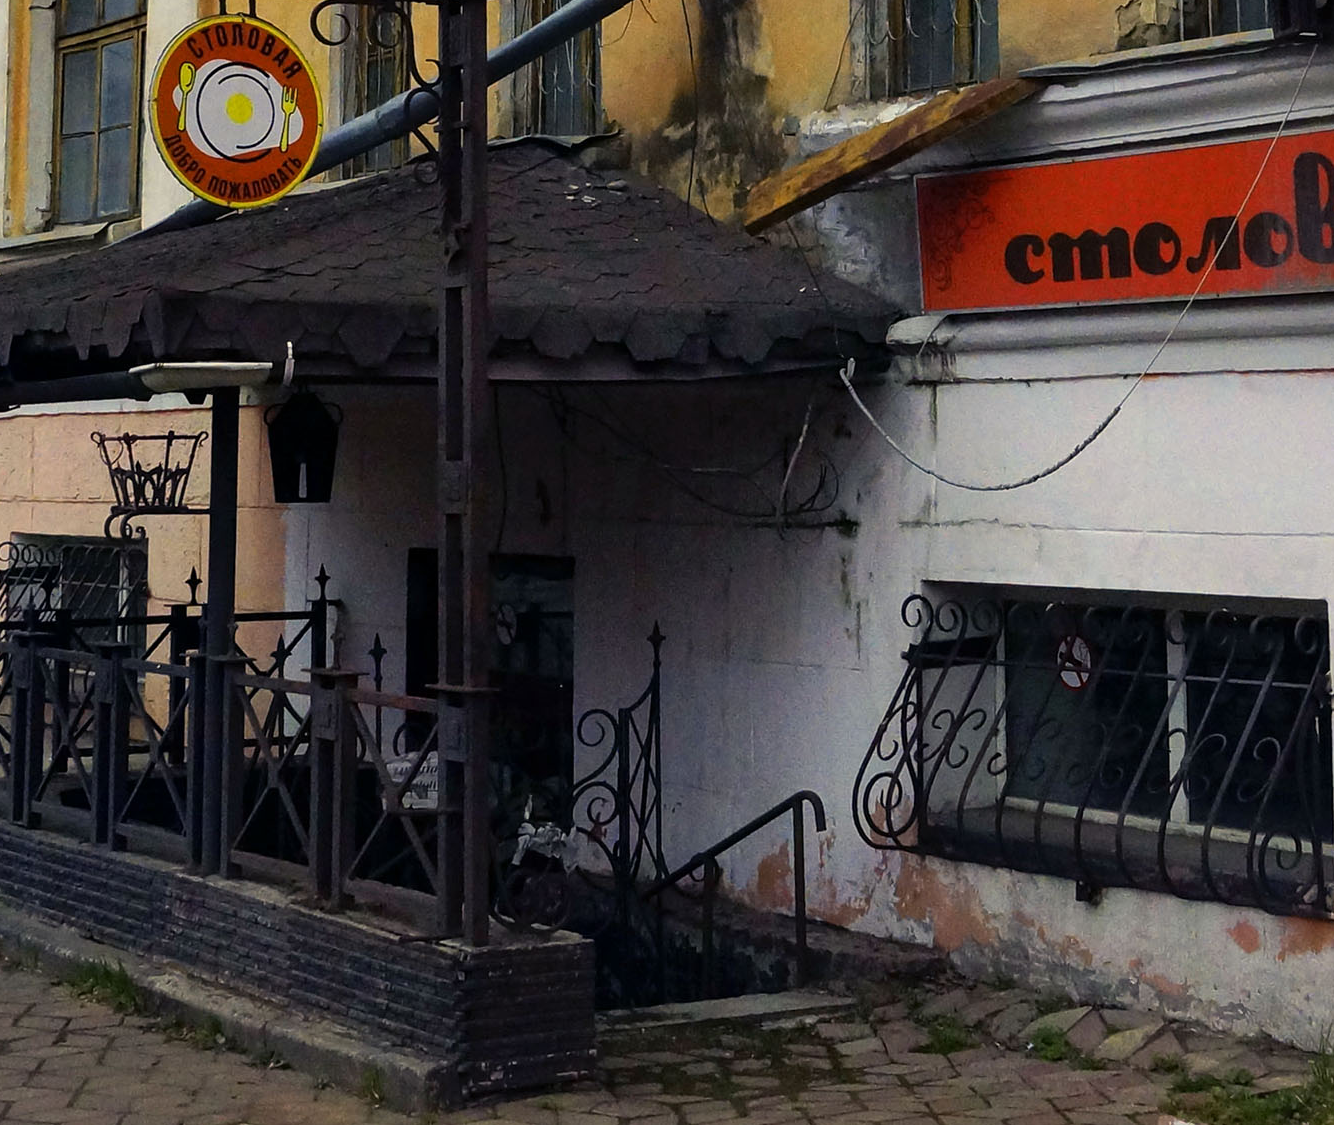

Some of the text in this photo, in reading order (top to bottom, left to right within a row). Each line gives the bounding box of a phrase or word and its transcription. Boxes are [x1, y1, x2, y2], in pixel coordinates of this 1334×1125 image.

[187, 24, 302, 78] СТОЛОВАЯ
[163, 134, 302, 200] ДОБРО ПОЖАЛОВАТЬ
